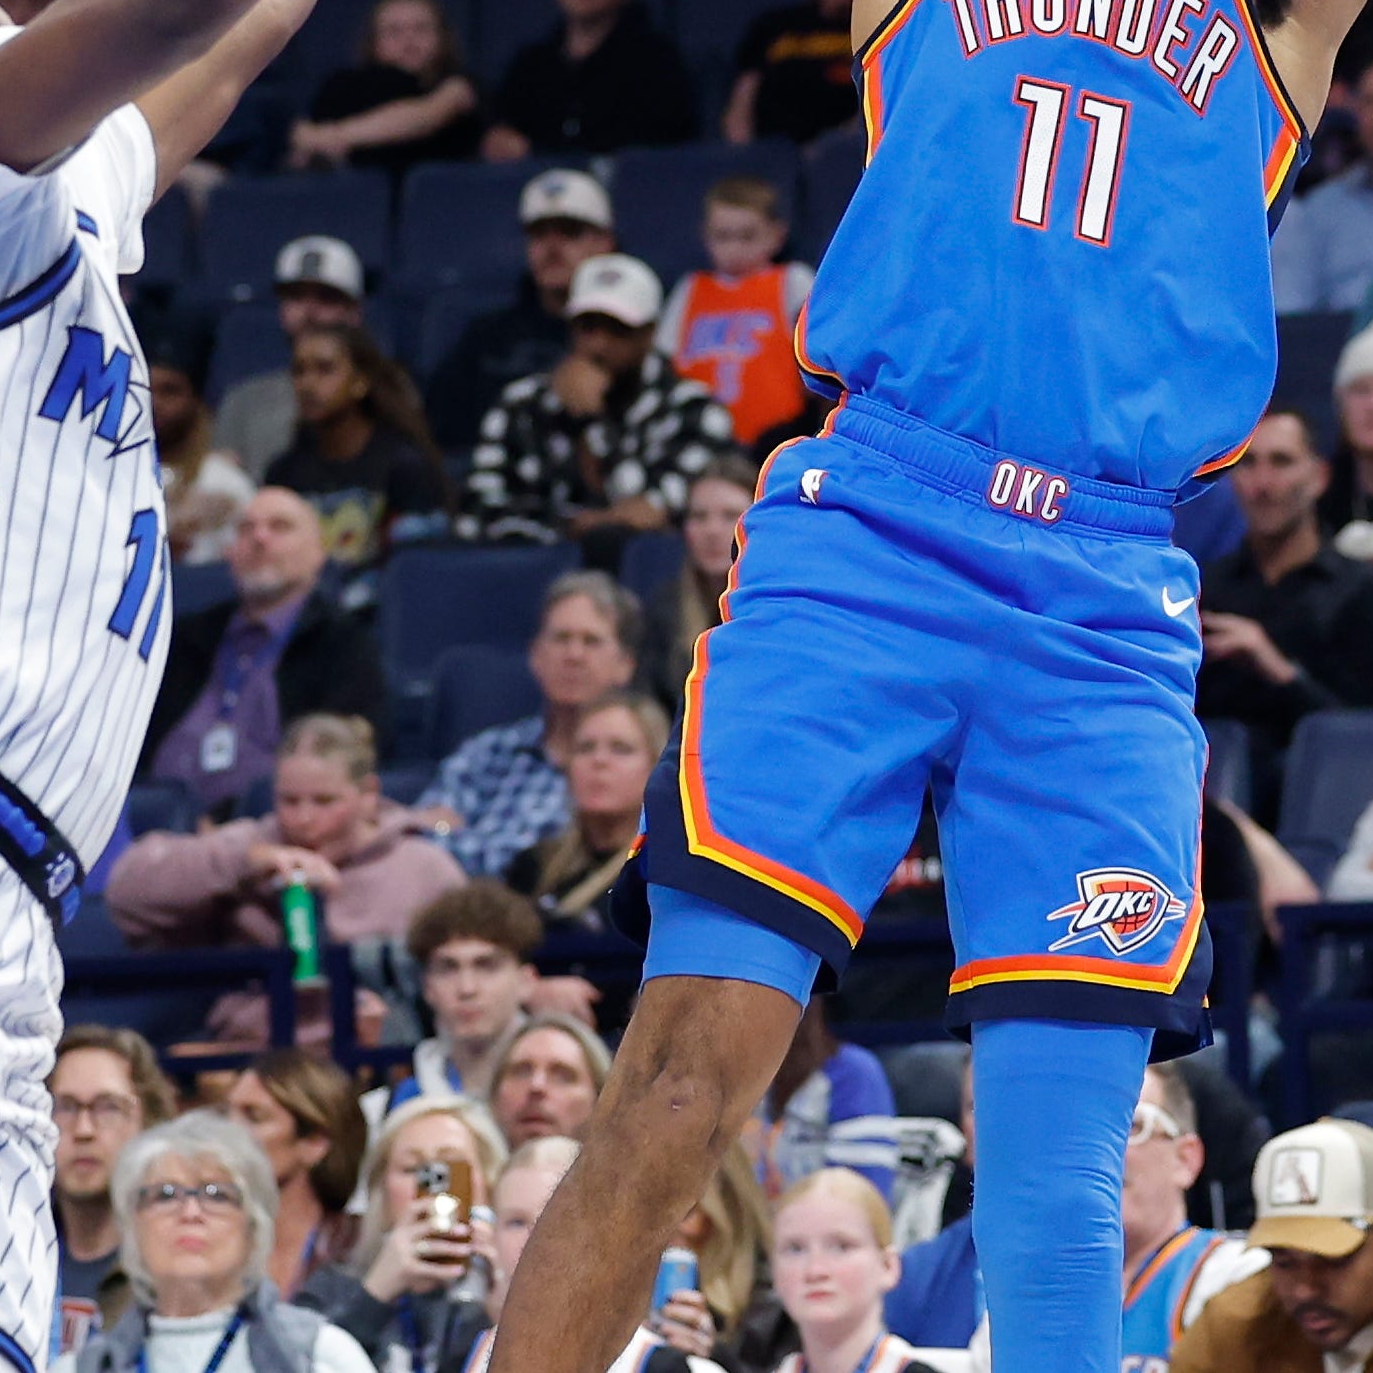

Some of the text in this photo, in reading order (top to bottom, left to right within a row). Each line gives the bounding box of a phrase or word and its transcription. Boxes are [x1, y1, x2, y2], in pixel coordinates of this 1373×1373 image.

[1012, 75, 1132, 248] 11
[987, 458, 1070, 524] OKC
[1074, 890, 1156, 931] OKC
